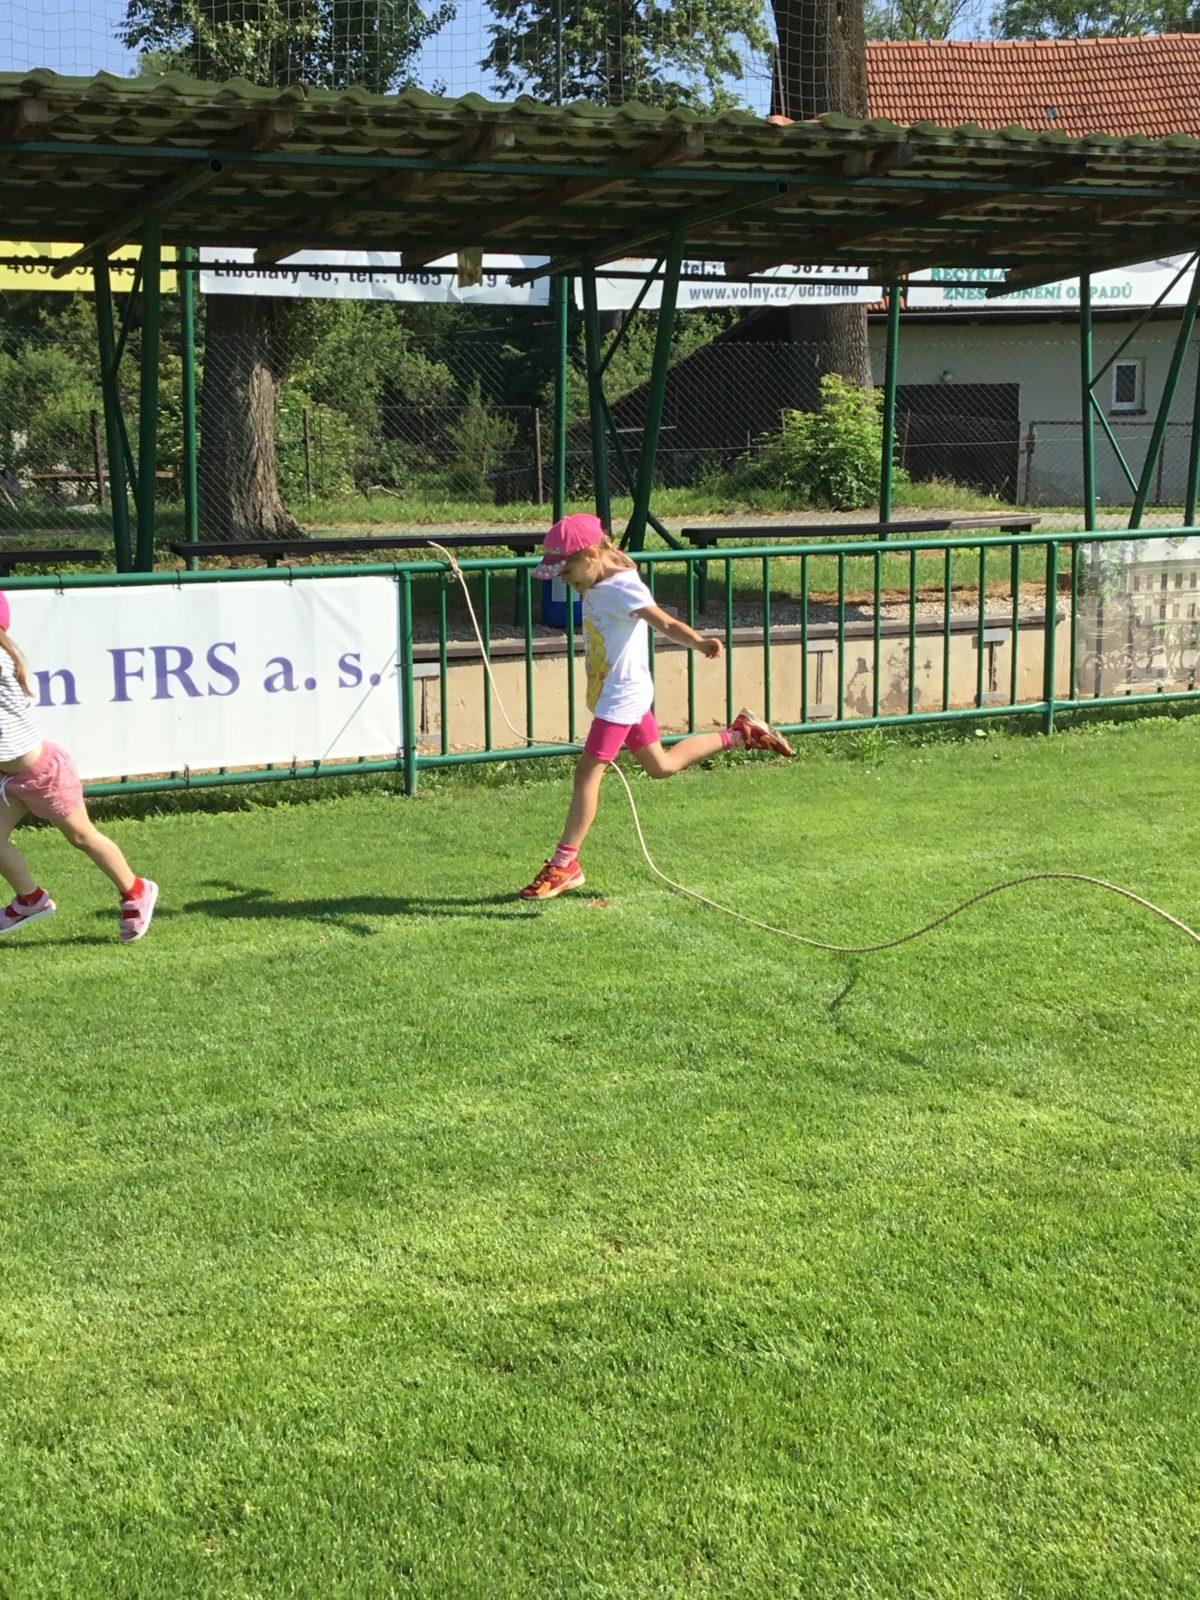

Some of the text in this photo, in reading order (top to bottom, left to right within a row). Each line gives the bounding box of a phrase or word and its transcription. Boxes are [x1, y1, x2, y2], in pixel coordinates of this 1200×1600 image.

[1066, 282, 1133, 299] OPADŮ
[106, 641, 241, 702] FRS
[263, 656, 317, 694] a.
[338, 652, 381, 689] s.
